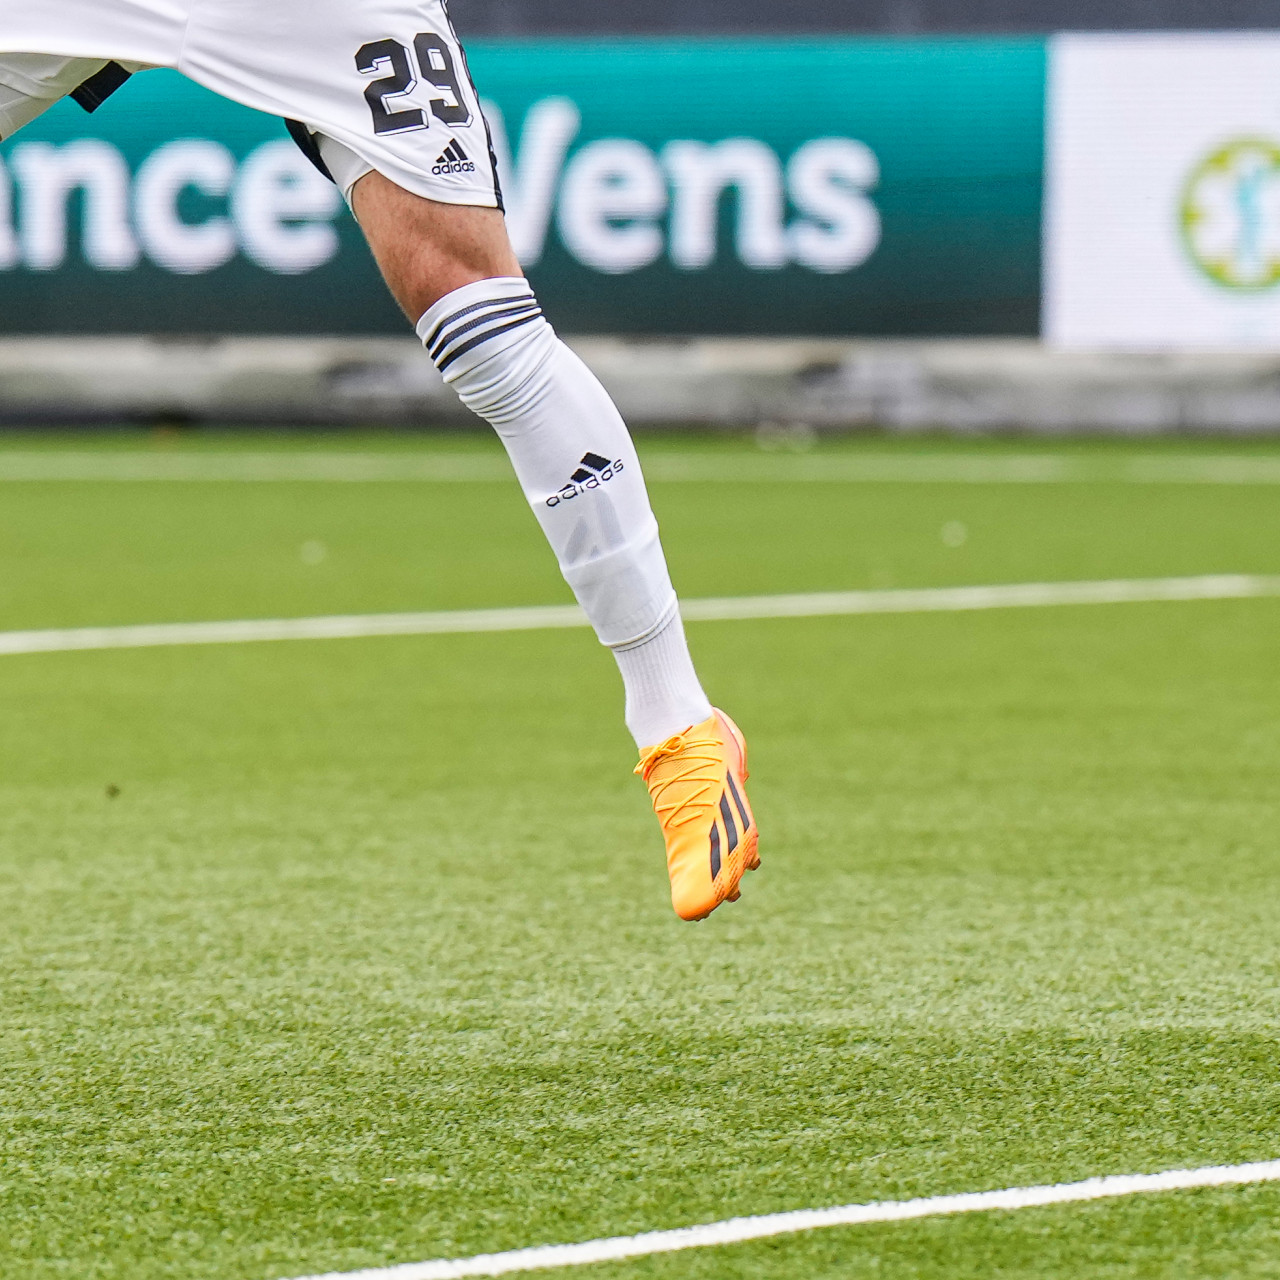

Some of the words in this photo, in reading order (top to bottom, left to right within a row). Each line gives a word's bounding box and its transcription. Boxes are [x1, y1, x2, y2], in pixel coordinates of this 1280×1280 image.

[354, 33, 474, 137] 29
[432, 160, 475, 175] adidas
[546, 458, 624, 507] adidas
